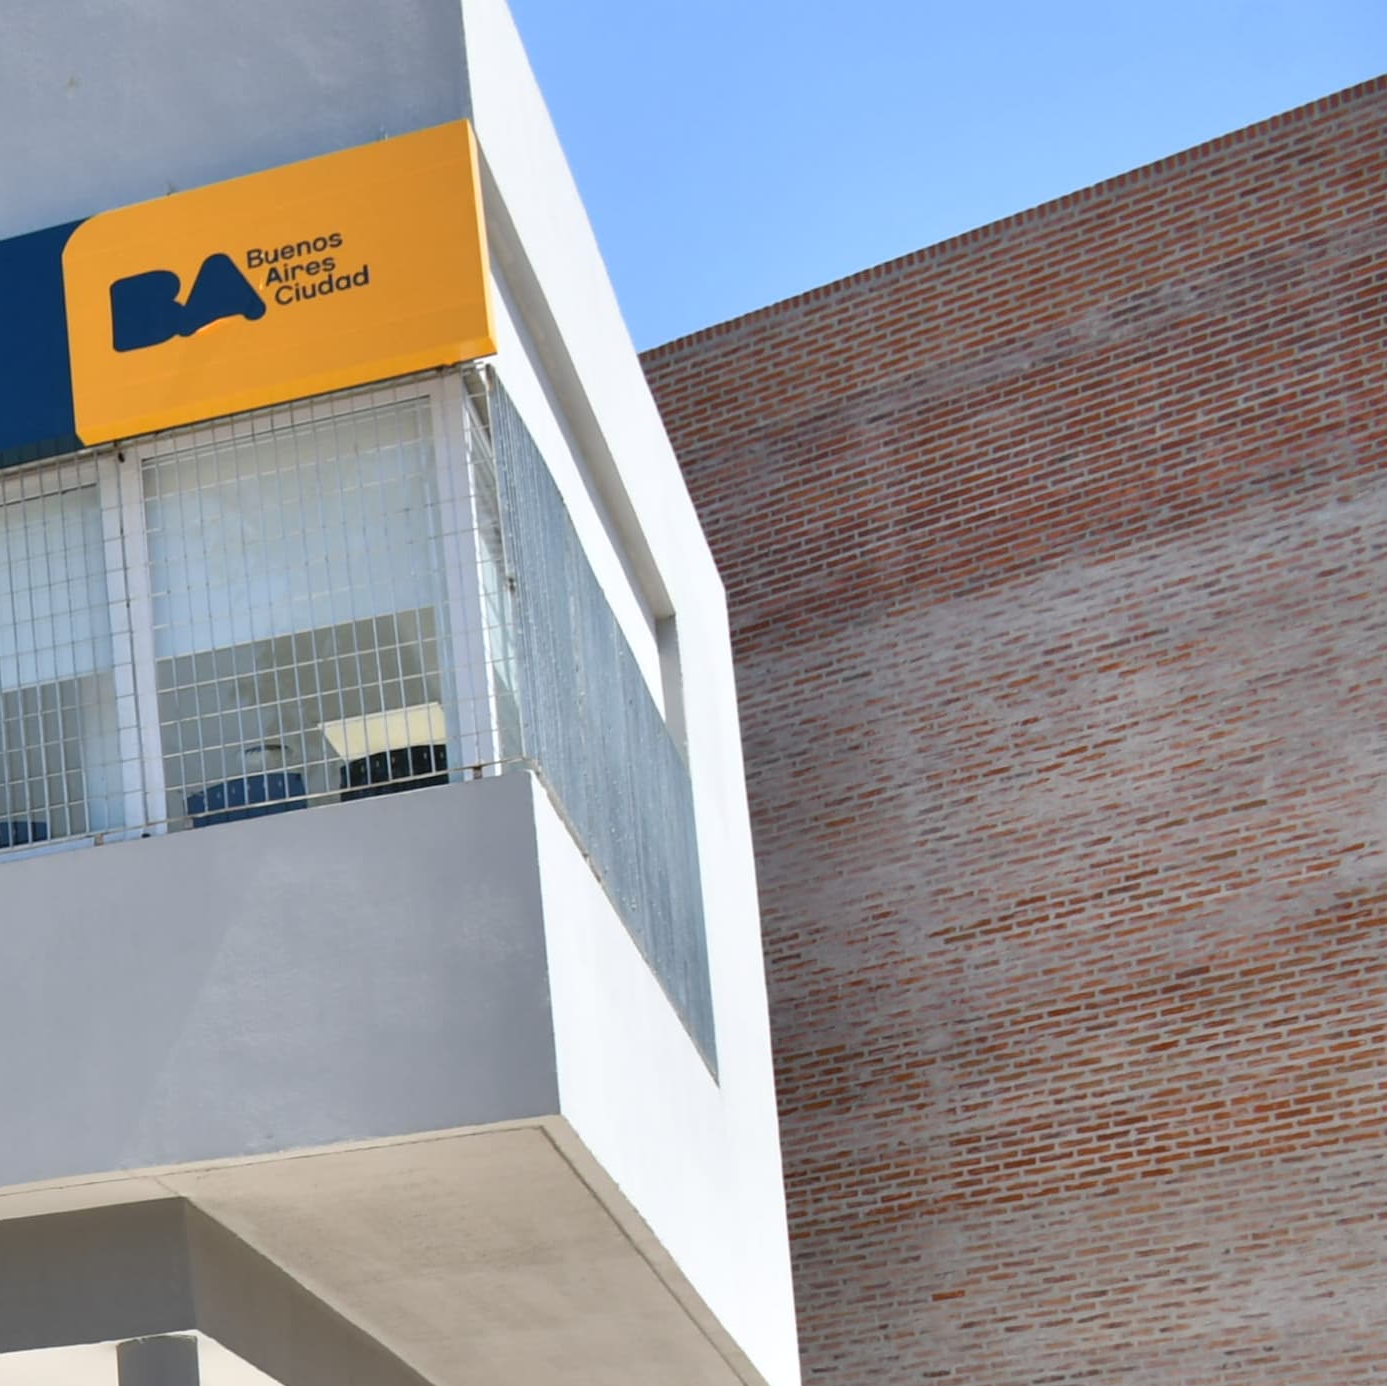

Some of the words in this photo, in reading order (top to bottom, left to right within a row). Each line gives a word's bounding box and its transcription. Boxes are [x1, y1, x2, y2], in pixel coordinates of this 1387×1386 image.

[246, 233, 343, 269] Buenos
[265, 257, 336, 286] Aires
[274, 264, 370, 305] Ciudad
